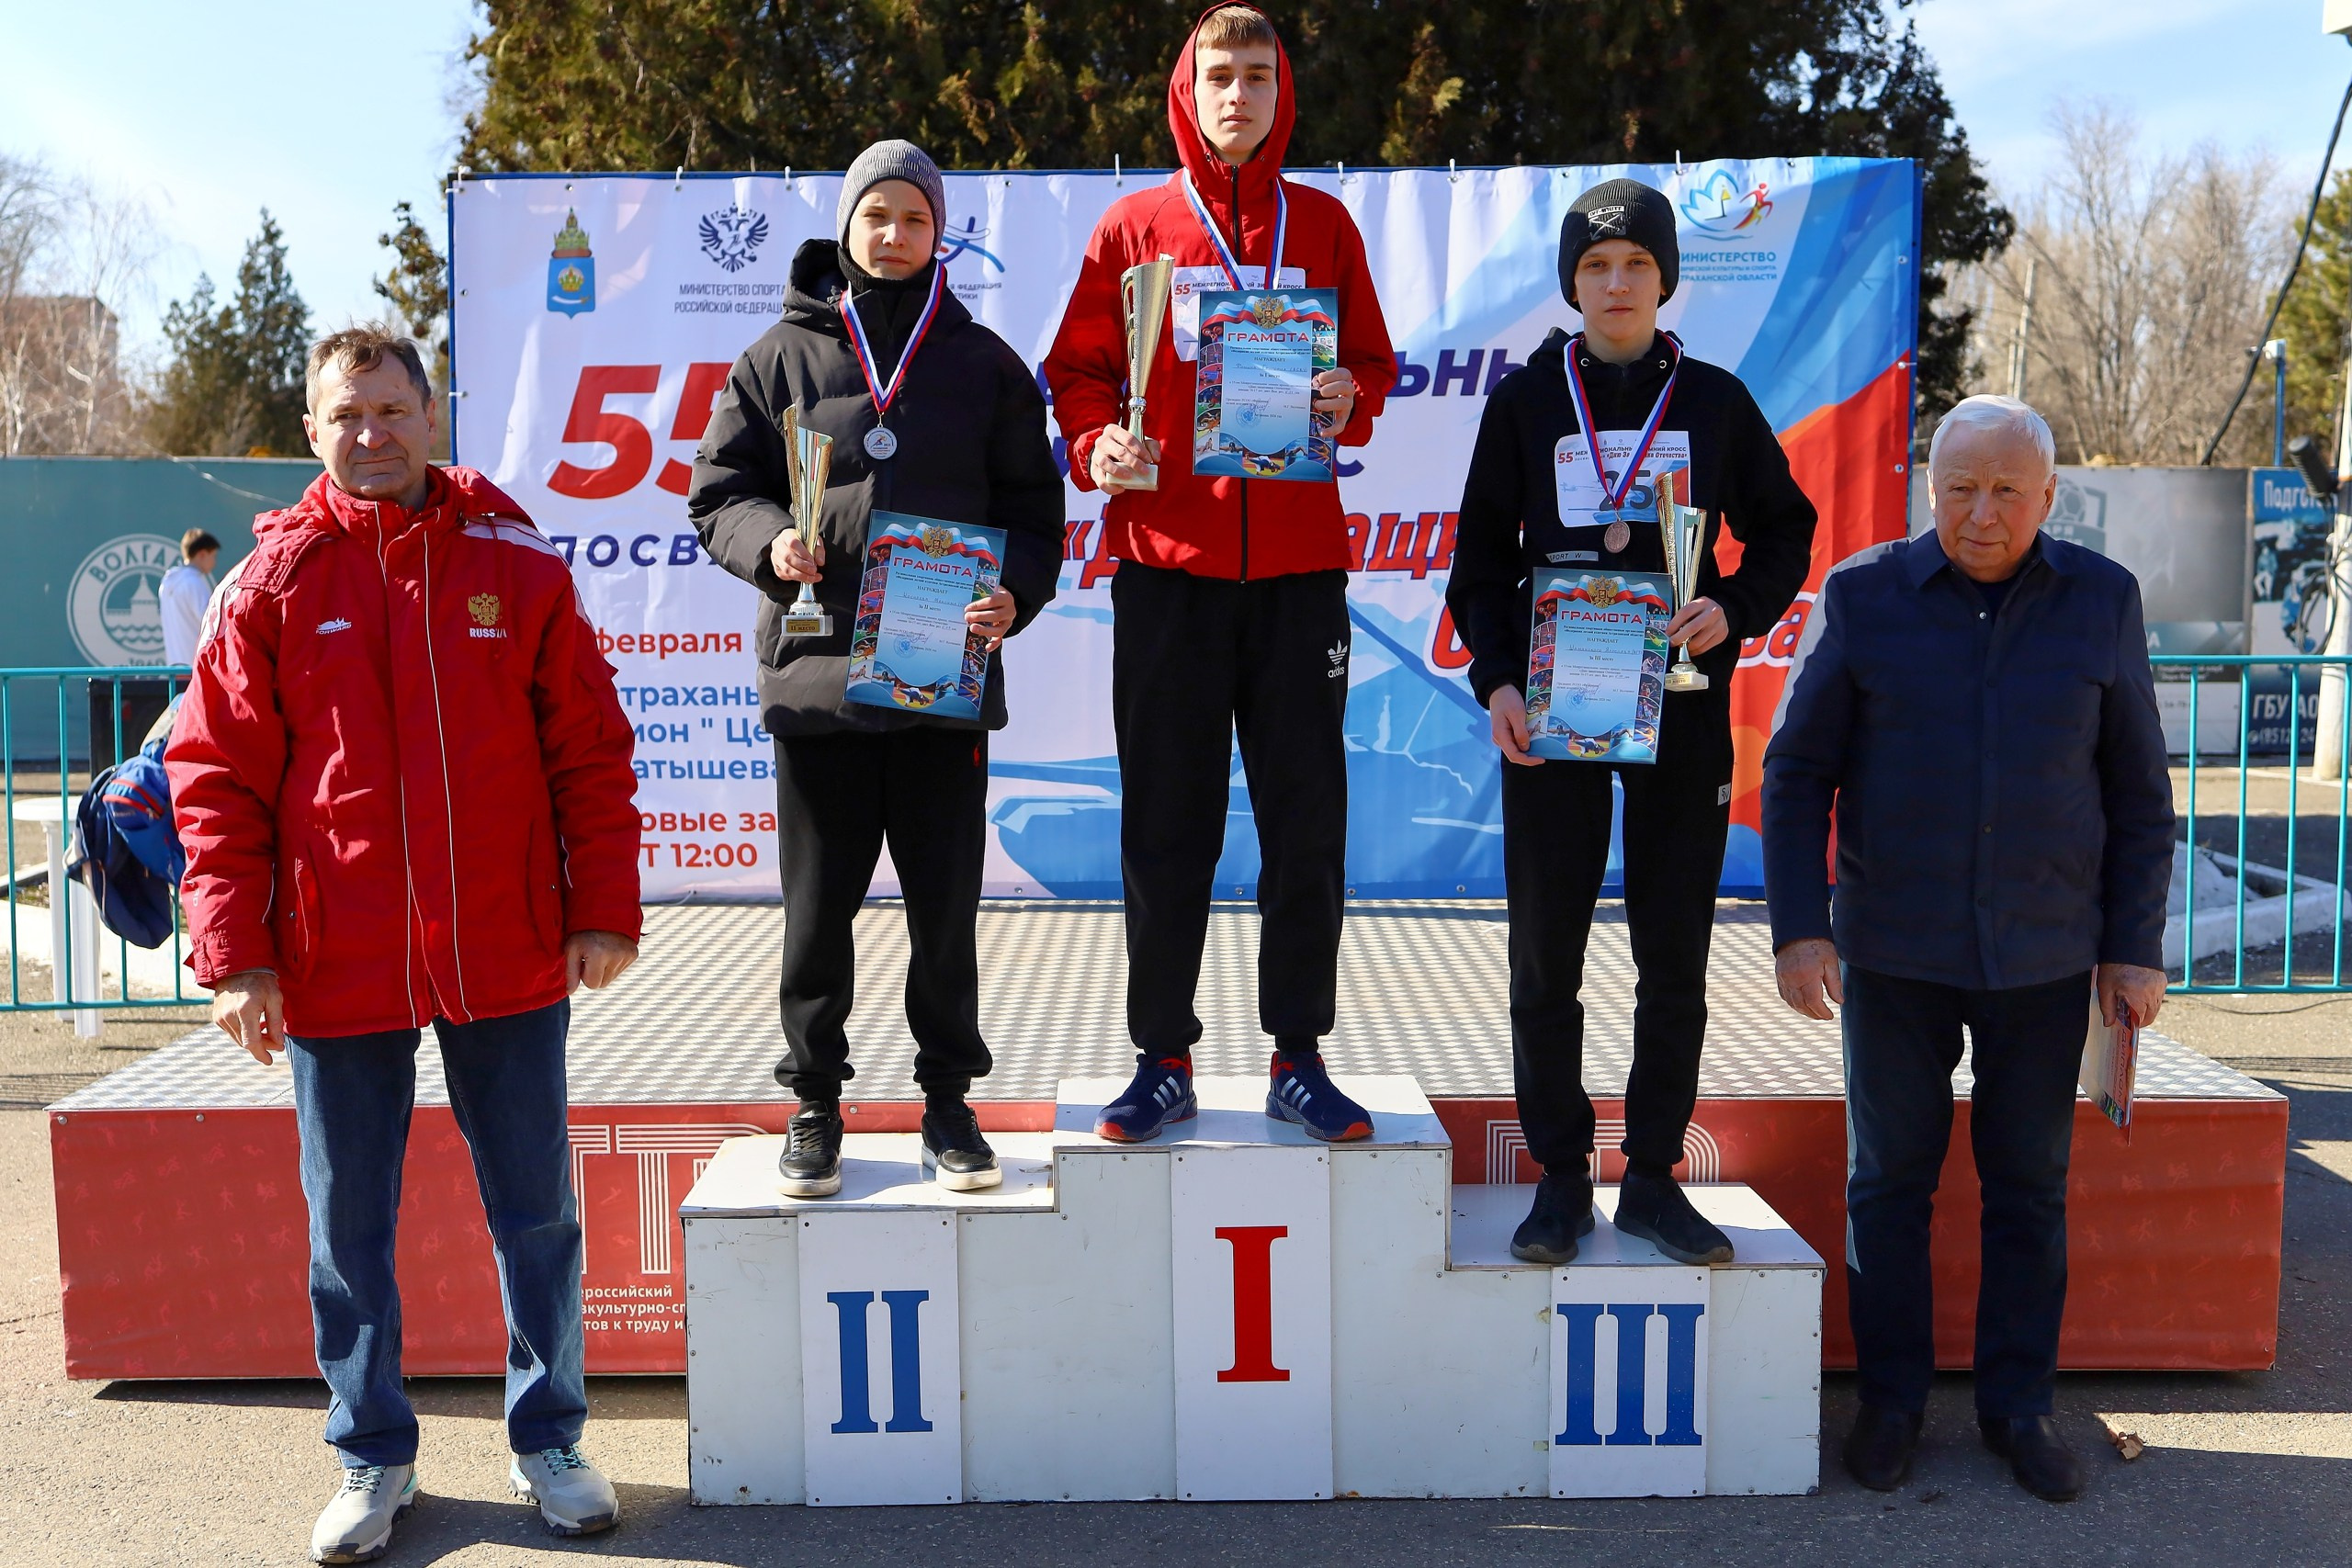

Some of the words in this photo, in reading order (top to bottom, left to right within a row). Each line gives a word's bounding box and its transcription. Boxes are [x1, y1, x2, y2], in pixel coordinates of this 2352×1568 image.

[1681, 252, 1776, 262] ИНИСТЕРСТВО
[957, 282, 1002, 290] ФЕДЕРАЦИЯ
[1736, 273, 1777, 281] ОБЛАСТИ
[679, 284, 750, 295] МИНИСТЕРСТВО
[1175, 284, 1191, 295] 55
[674, 299, 732, 313] РОССИЙСКОЙ
[1227, 333, 1309, 343] ГРАМОТА
[1557, 452, 1573, 464] 55
[1599, 470, 1653, 511] 25
[549, 534, 716, 567] ПОСВ
[893, 557, 973, 578] ГРАМОТА
[1561, 611, 1643, 624] ГРАМОТА
[469, 627, 507, 637] RUSSIA
[596, 627, 741, 660] февраля
[617, 686, 760, 713] трахань
[2253, 694, 2289, 719] ГБУ
[633, 759, 776, 779] атышев
[640, 812, 727, 832] овые
[739, 812, 776, 832] за
[671, 842, 757, 868] 12:00
[1215, 1225, 1290, 1382] I
[614, 1320, 622, 1330] к
[626, 1320, 670, 1333] труду
[675, 1320, 684, 1330] и
[826, 1290, 933, 1434] II
[1555, 1303, 1705, 1446] III
